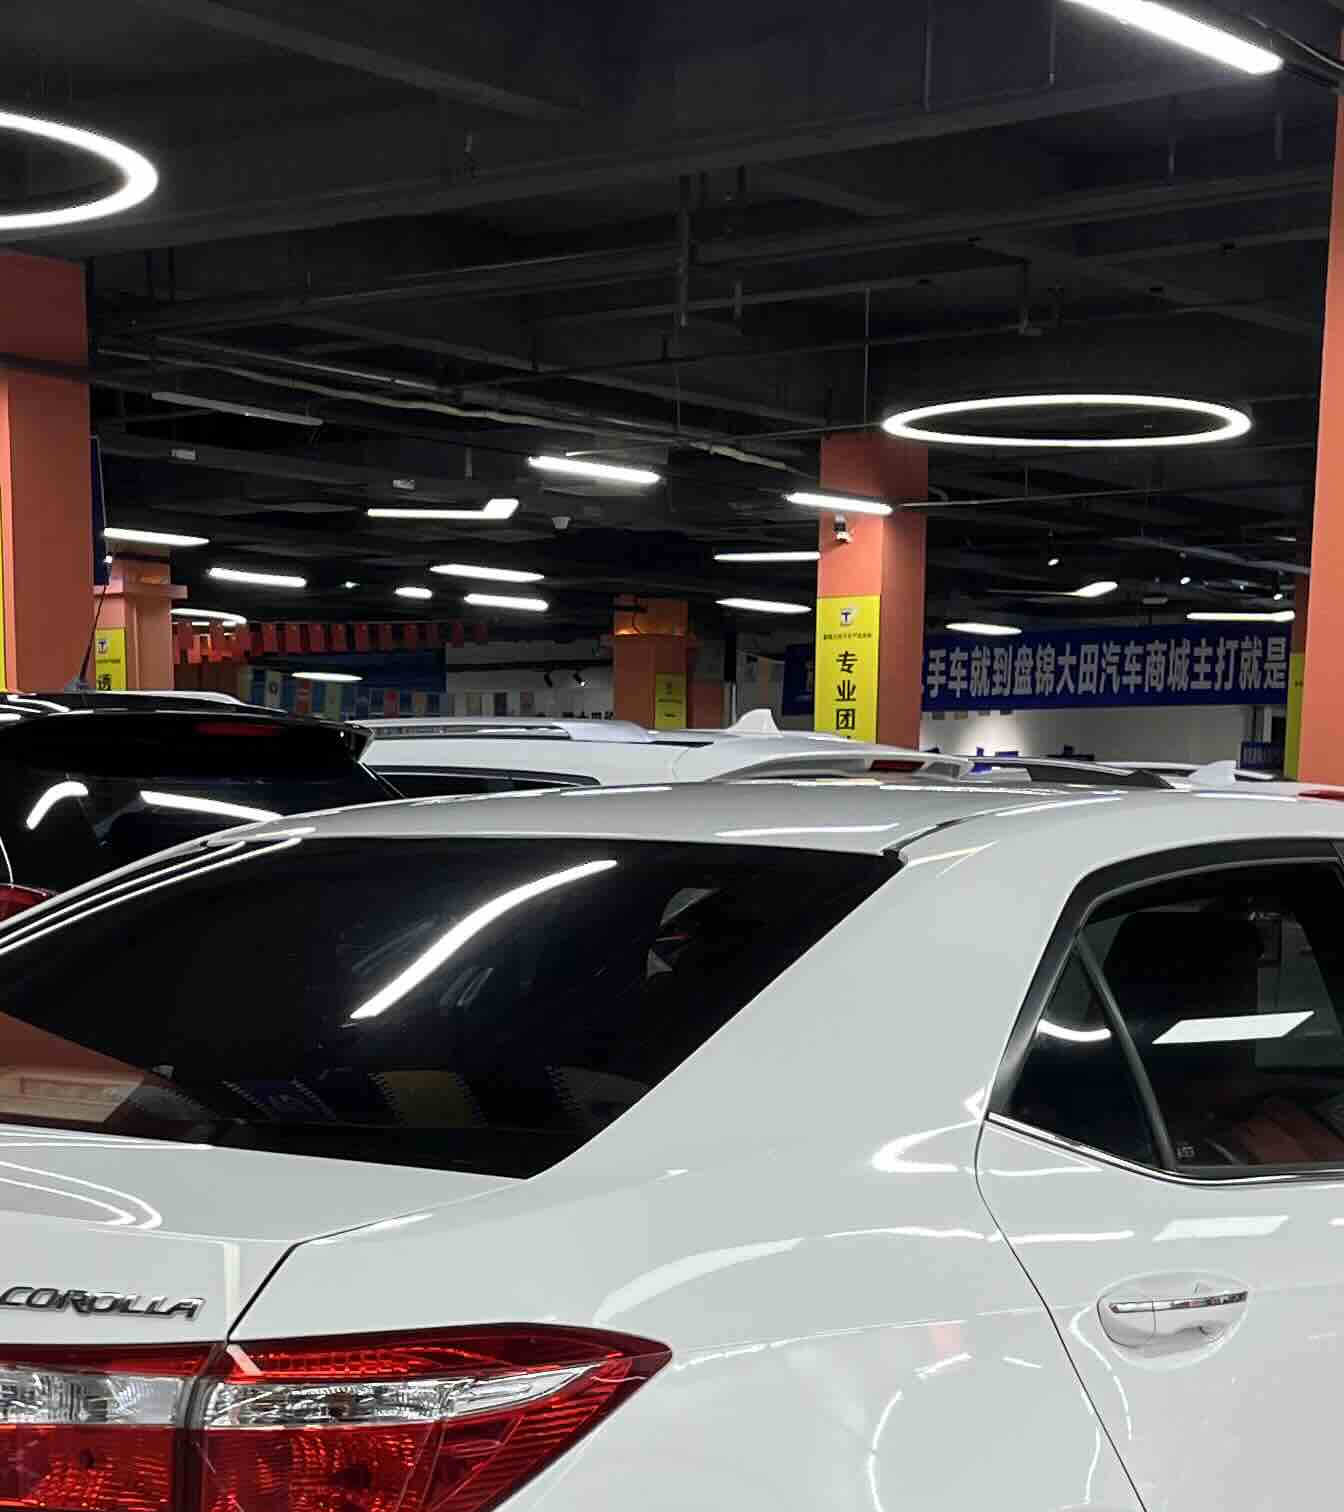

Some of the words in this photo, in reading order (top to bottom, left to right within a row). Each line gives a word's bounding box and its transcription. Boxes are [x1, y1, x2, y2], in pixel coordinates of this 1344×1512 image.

[835, 650, 858, 739] 专业团
[921, 635, 1288, 698] 手车就到盘锦大田汽车商城主打就是
